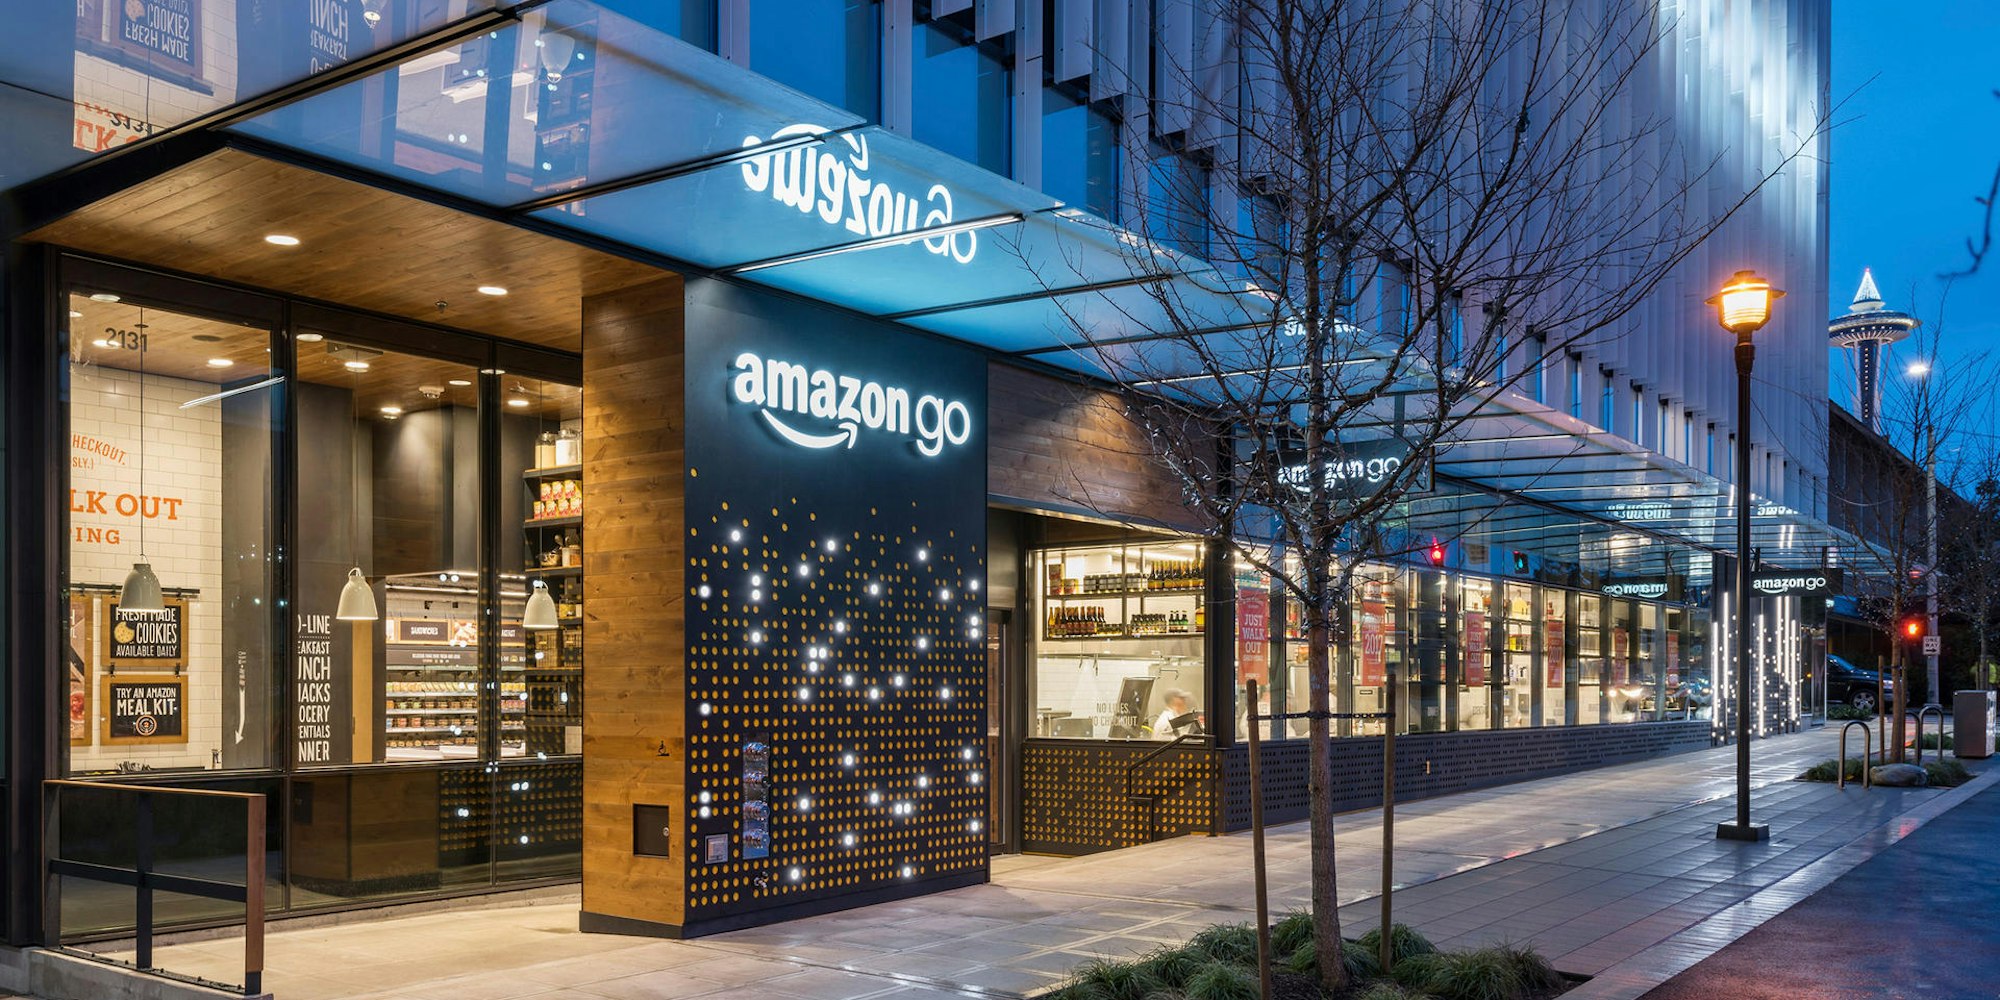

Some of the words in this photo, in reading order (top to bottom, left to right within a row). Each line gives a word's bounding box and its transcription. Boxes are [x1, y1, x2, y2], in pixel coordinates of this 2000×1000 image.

[104, 327, 149, 352] 2131
[735, 353, 910, 436] amazon
[915, 395, 971, 457] go
[1366, 457, 1402, 483] go
[115, 493, 183, 520] OUT
[71, 526, 121, 545] ING
[1753, 578, 1805, 592] amazon
[1806, 577, 1827, 591] go
[116, 608, 149, 621] FRESH
[150, 607, 176, 622] MADE
[1244, 613, 1264, 627] JUST
[136, 622, 177, 644] COOKIES
[1242, 627, 1265, 641] WALK
[115, 645, 154, 658] AVAILABLE
[156, 645, 178, 657] DAILY
[1245, 641, 1262, 654] OUT
[116, 687, 131, 699] TRY
[132, 687, 144, 699] AN
[146, 687, 177, 699] AMAZON
[116, 698, 151, 716] MEAL
[153, 698, 176, 716] KIT
[298, 725, 331, 739] ENTIALS
